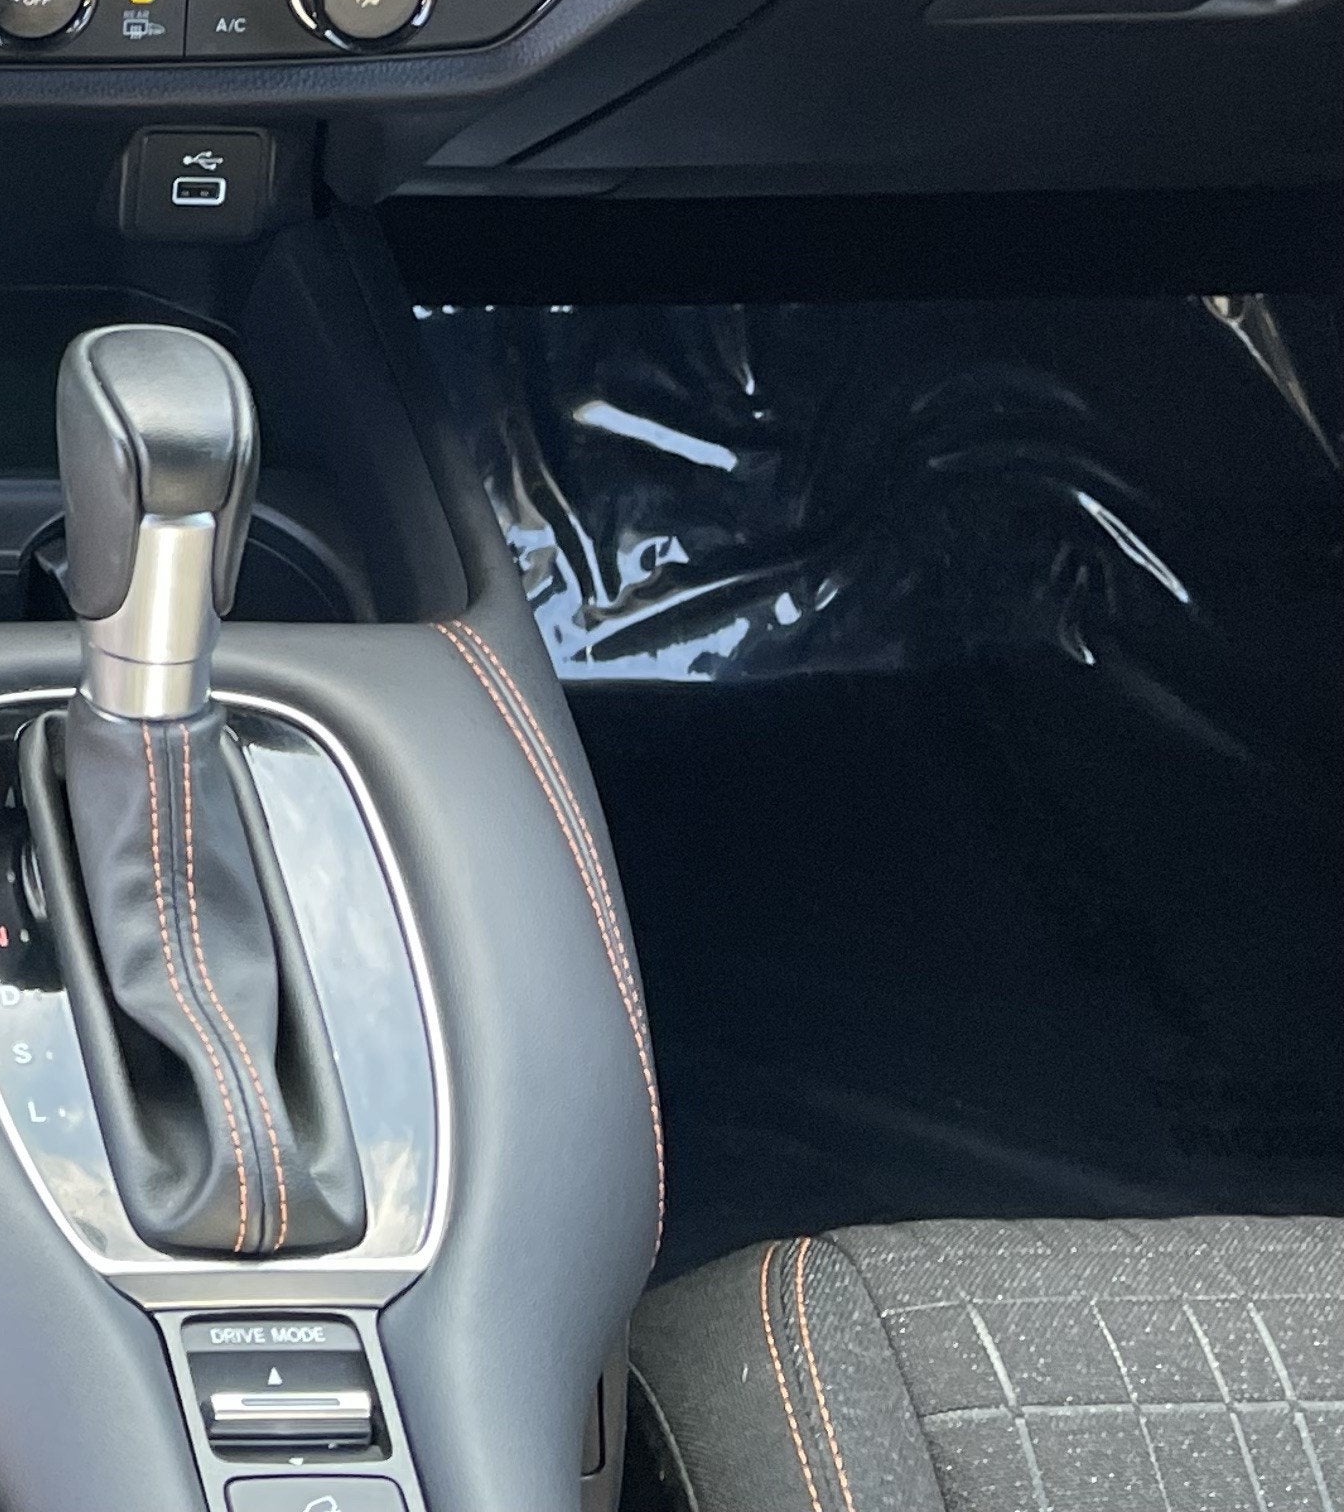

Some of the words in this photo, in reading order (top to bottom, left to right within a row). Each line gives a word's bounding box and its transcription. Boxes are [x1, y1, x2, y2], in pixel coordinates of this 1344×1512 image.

[215, 17, 246, 33] A/C
[13, 1044, 32, 1064] S
[28, 1100, 47, 1124] L
[211, 1327, 265, 1344] DRIVE
[272, 1327, 325, 1344] MODE
